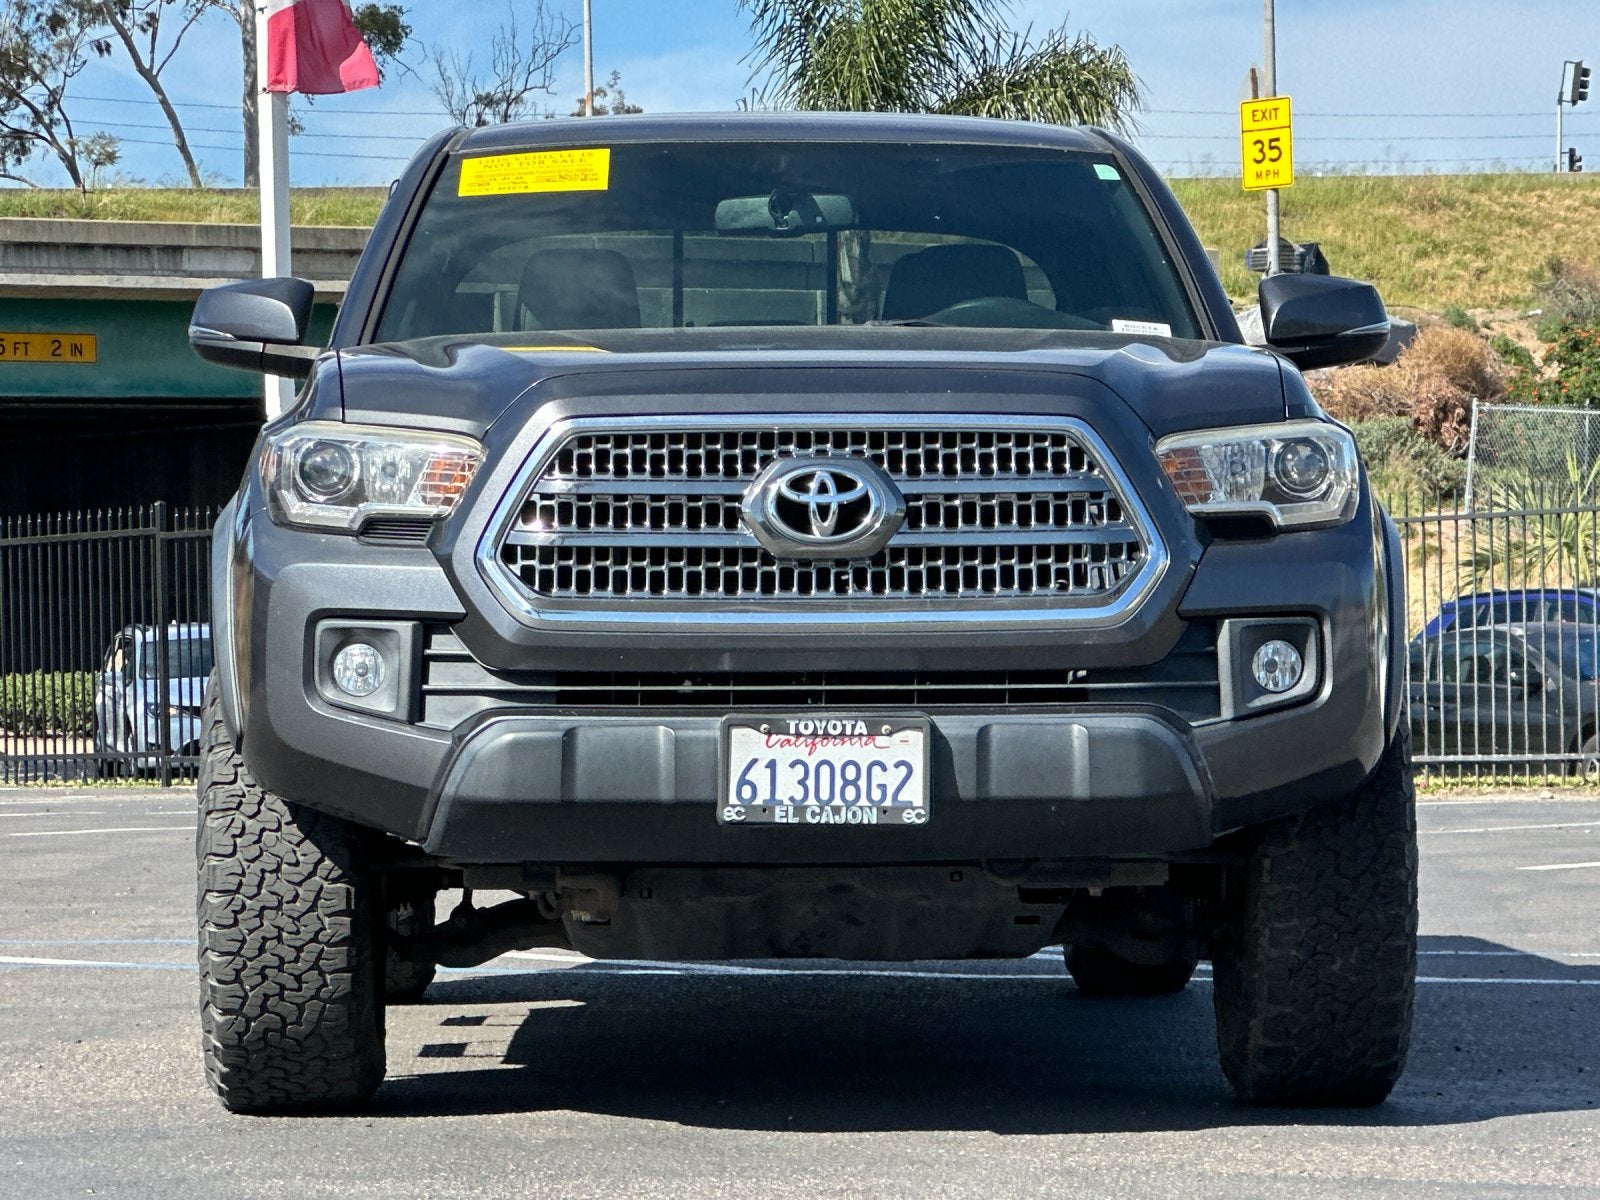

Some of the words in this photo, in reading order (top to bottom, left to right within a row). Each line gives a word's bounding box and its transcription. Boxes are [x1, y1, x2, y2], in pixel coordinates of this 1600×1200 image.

[1252, 108, 1280, 122] EXIT
[514, 153, 574, 161] VEHICLE
[1253, 137, 1282, 164] 35
[519, 159, 545, 167] FOR
[1256, 169, 1280, 181] MPH
[13, 342, 30, 356] FT
[51, 339, 62, 356] 2
[70, 343, 83, 357] IN
[786, 719, 868, 736] TOYOTA
[735, 757, 914, 806] 61308G2
[774, 806, 800, 824] EL
[805, 806, 878, 825] CAJON
